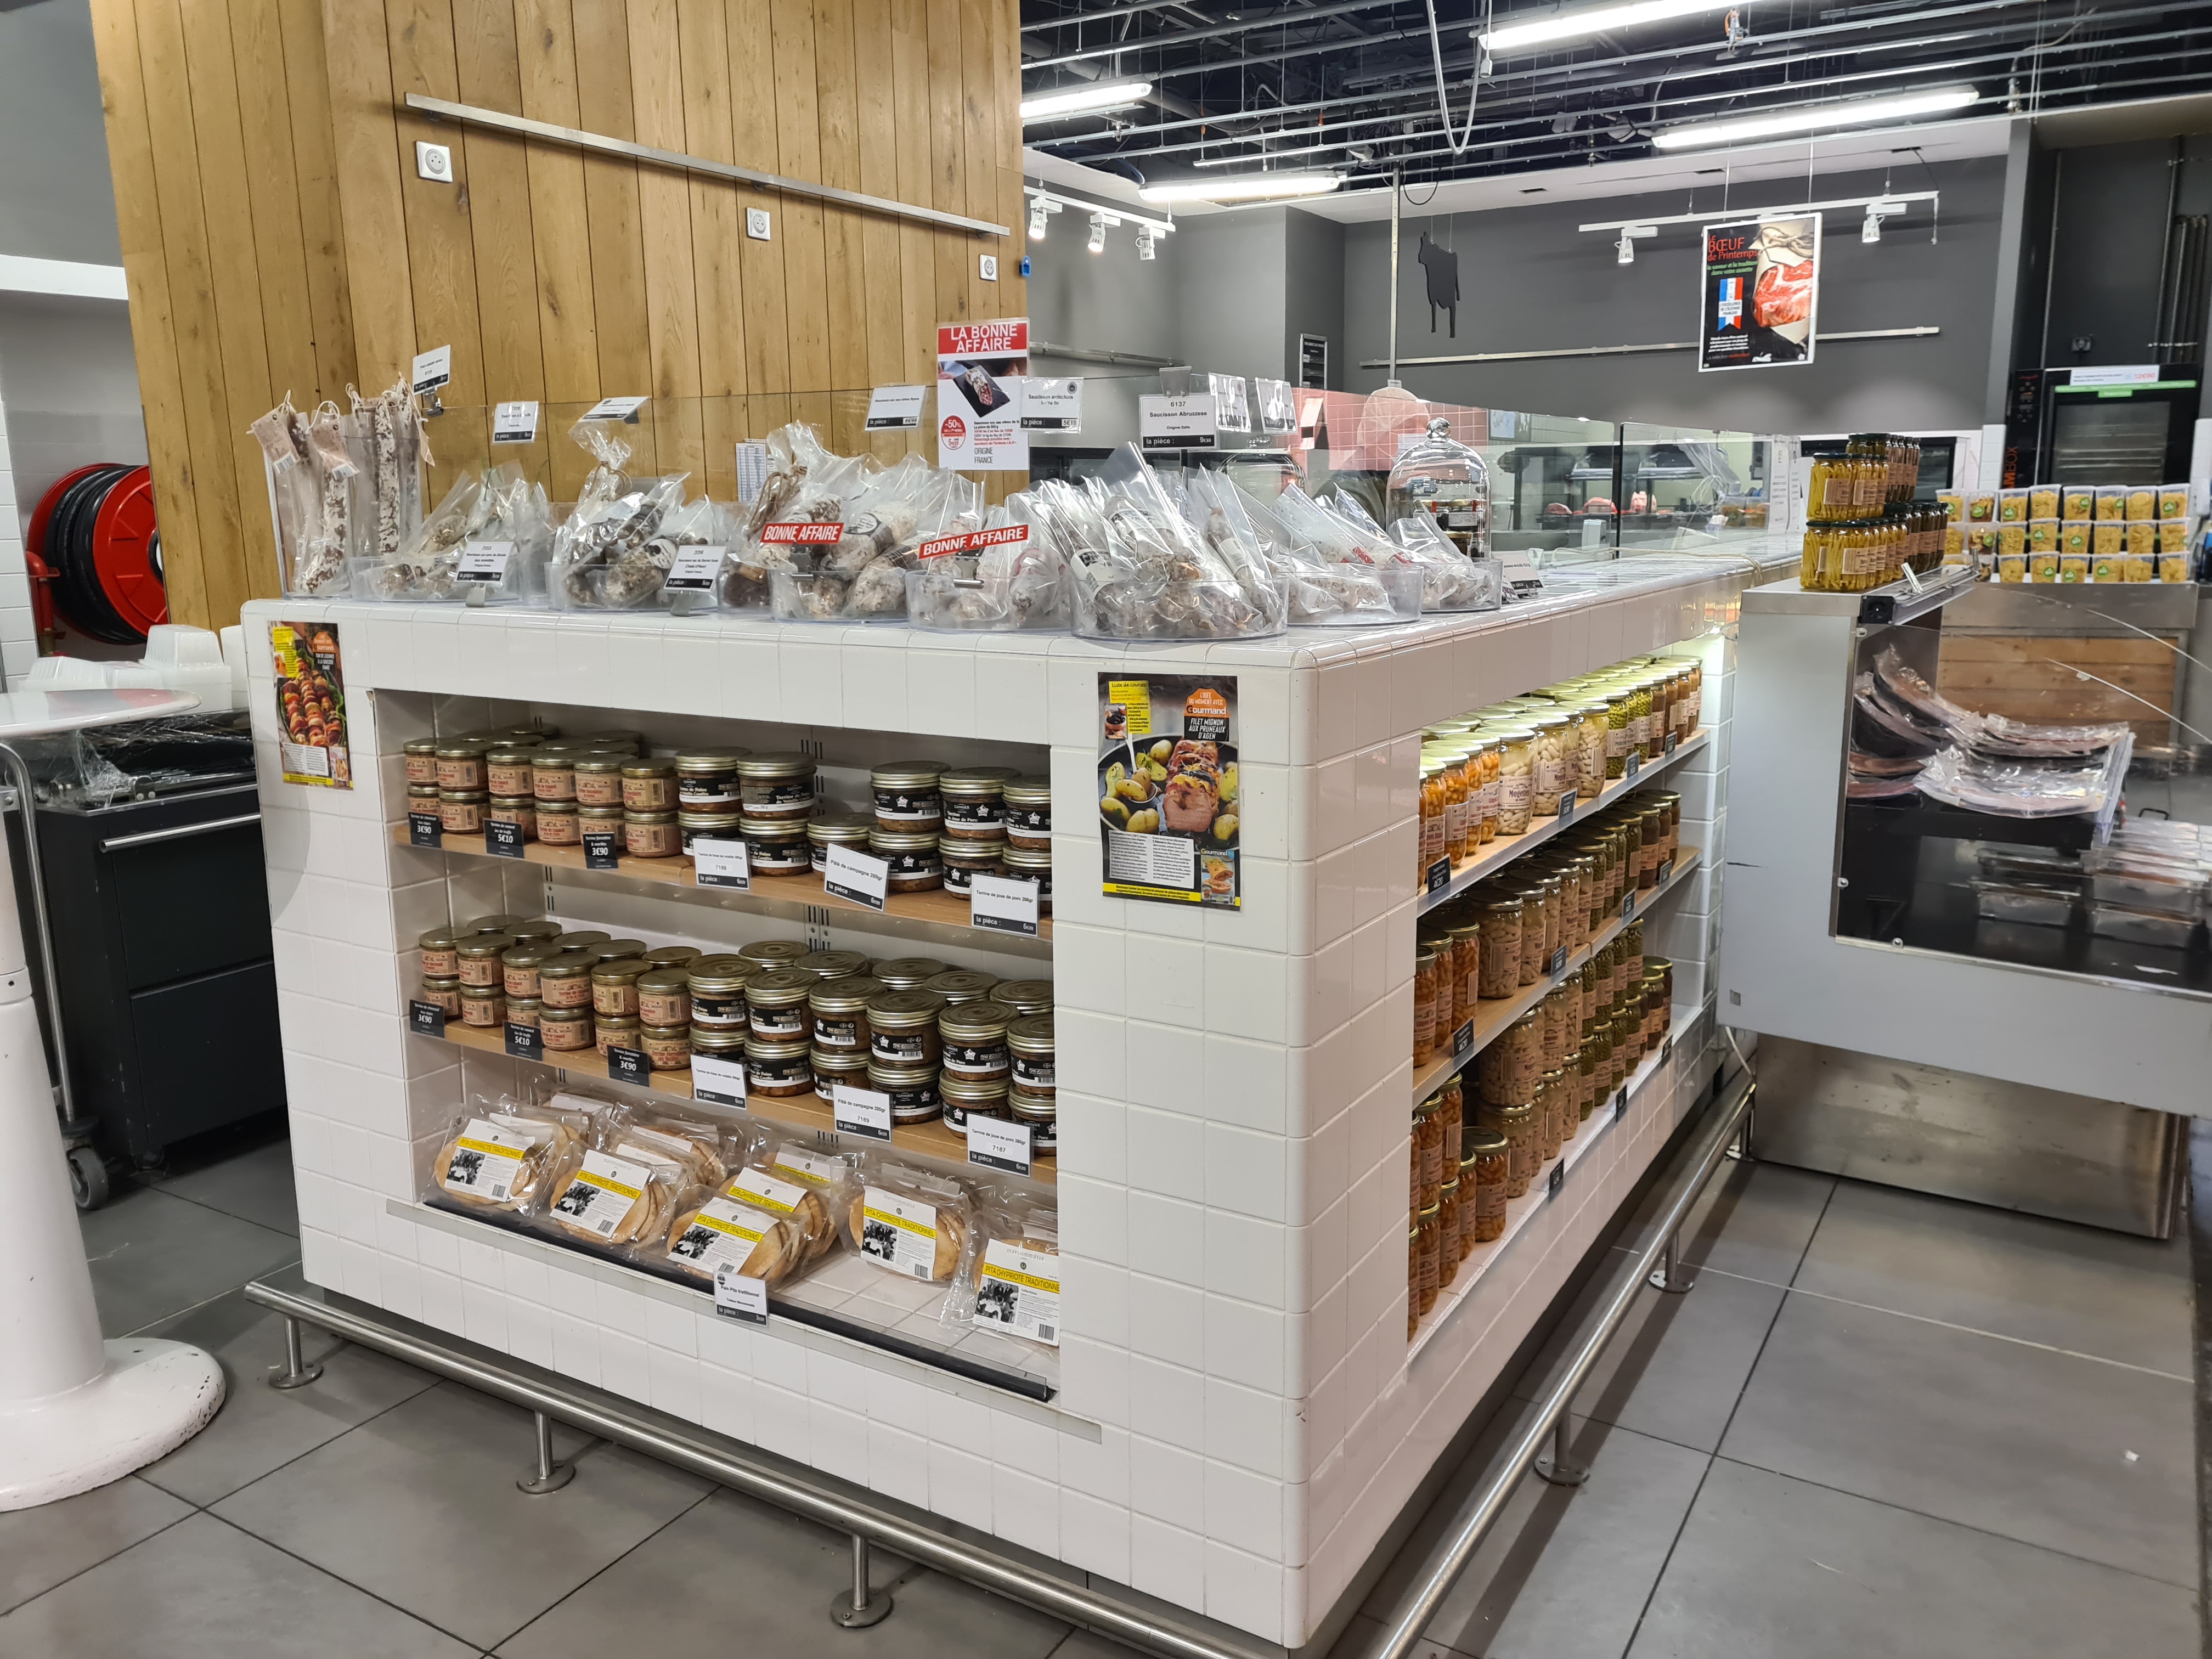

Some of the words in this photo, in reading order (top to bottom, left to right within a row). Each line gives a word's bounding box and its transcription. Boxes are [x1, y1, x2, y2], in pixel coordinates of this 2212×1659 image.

[1708, 237, 1745, 252] BŒUF
[1708, 252, 1717, 261] de
[1718, 250, 1758, 259] Printemps
[951, 327, 967, 340] LA
[971, 324, 1018, 339] BONNE
[956, 337, 1012, 353] AFFAIRE
[945, 419, 962, 428] -50%
[764, 526, 798, 541] BONNE
[797, 525, 840, 541] AFFAIRE
[923, 537, 966, 557] BONNE
[969, 527, 1024, 547] AFFAIRE
[1187, 705, 1226, 714] Gourmand
[417, 825, 431, 834] 3€90
[498, 834, 513, 843] 5€10
[592, 847, 608, 856] 3€90
[847, 866, 869, 876] campagne
[834, 885, 848, 894] pièce
[983, 917, 997, 926] pièce
[417, 1014, 432, 1024] 3€90
[515, 1036, 530, 1046] 5€10
[620, 1060, 636, 1071] 3€90
[703, 1091, 715, 1099] pièce
[470, 1141, 492, 1151] CHYPRIOTE
[493, 1146, 521, 1158] TRADITIONNEL
[588, 1175, 610, 1187] CHYPRIOTE
[610, 1182, 639, 1198] TRADITIONNEL
[740, 1191, 763, 1204] CHYPRIOTE
[866, 1208, 876, 1216] PITA
[877, 1211, 901, 1226] CHYPRIOTE
[902, 1219, 934, 1237] TRADITIONNEL
[706, 1217, 730, 1230] CHYPRIOTE
[730, 1224, 759, 1240] TRADITIONNEL
[986, 1265, 996, 1274] PITA
[996, 1269, 1024, 1282] CHYPRIOTE
[738, 1289, 759, 1297] traditionnel
